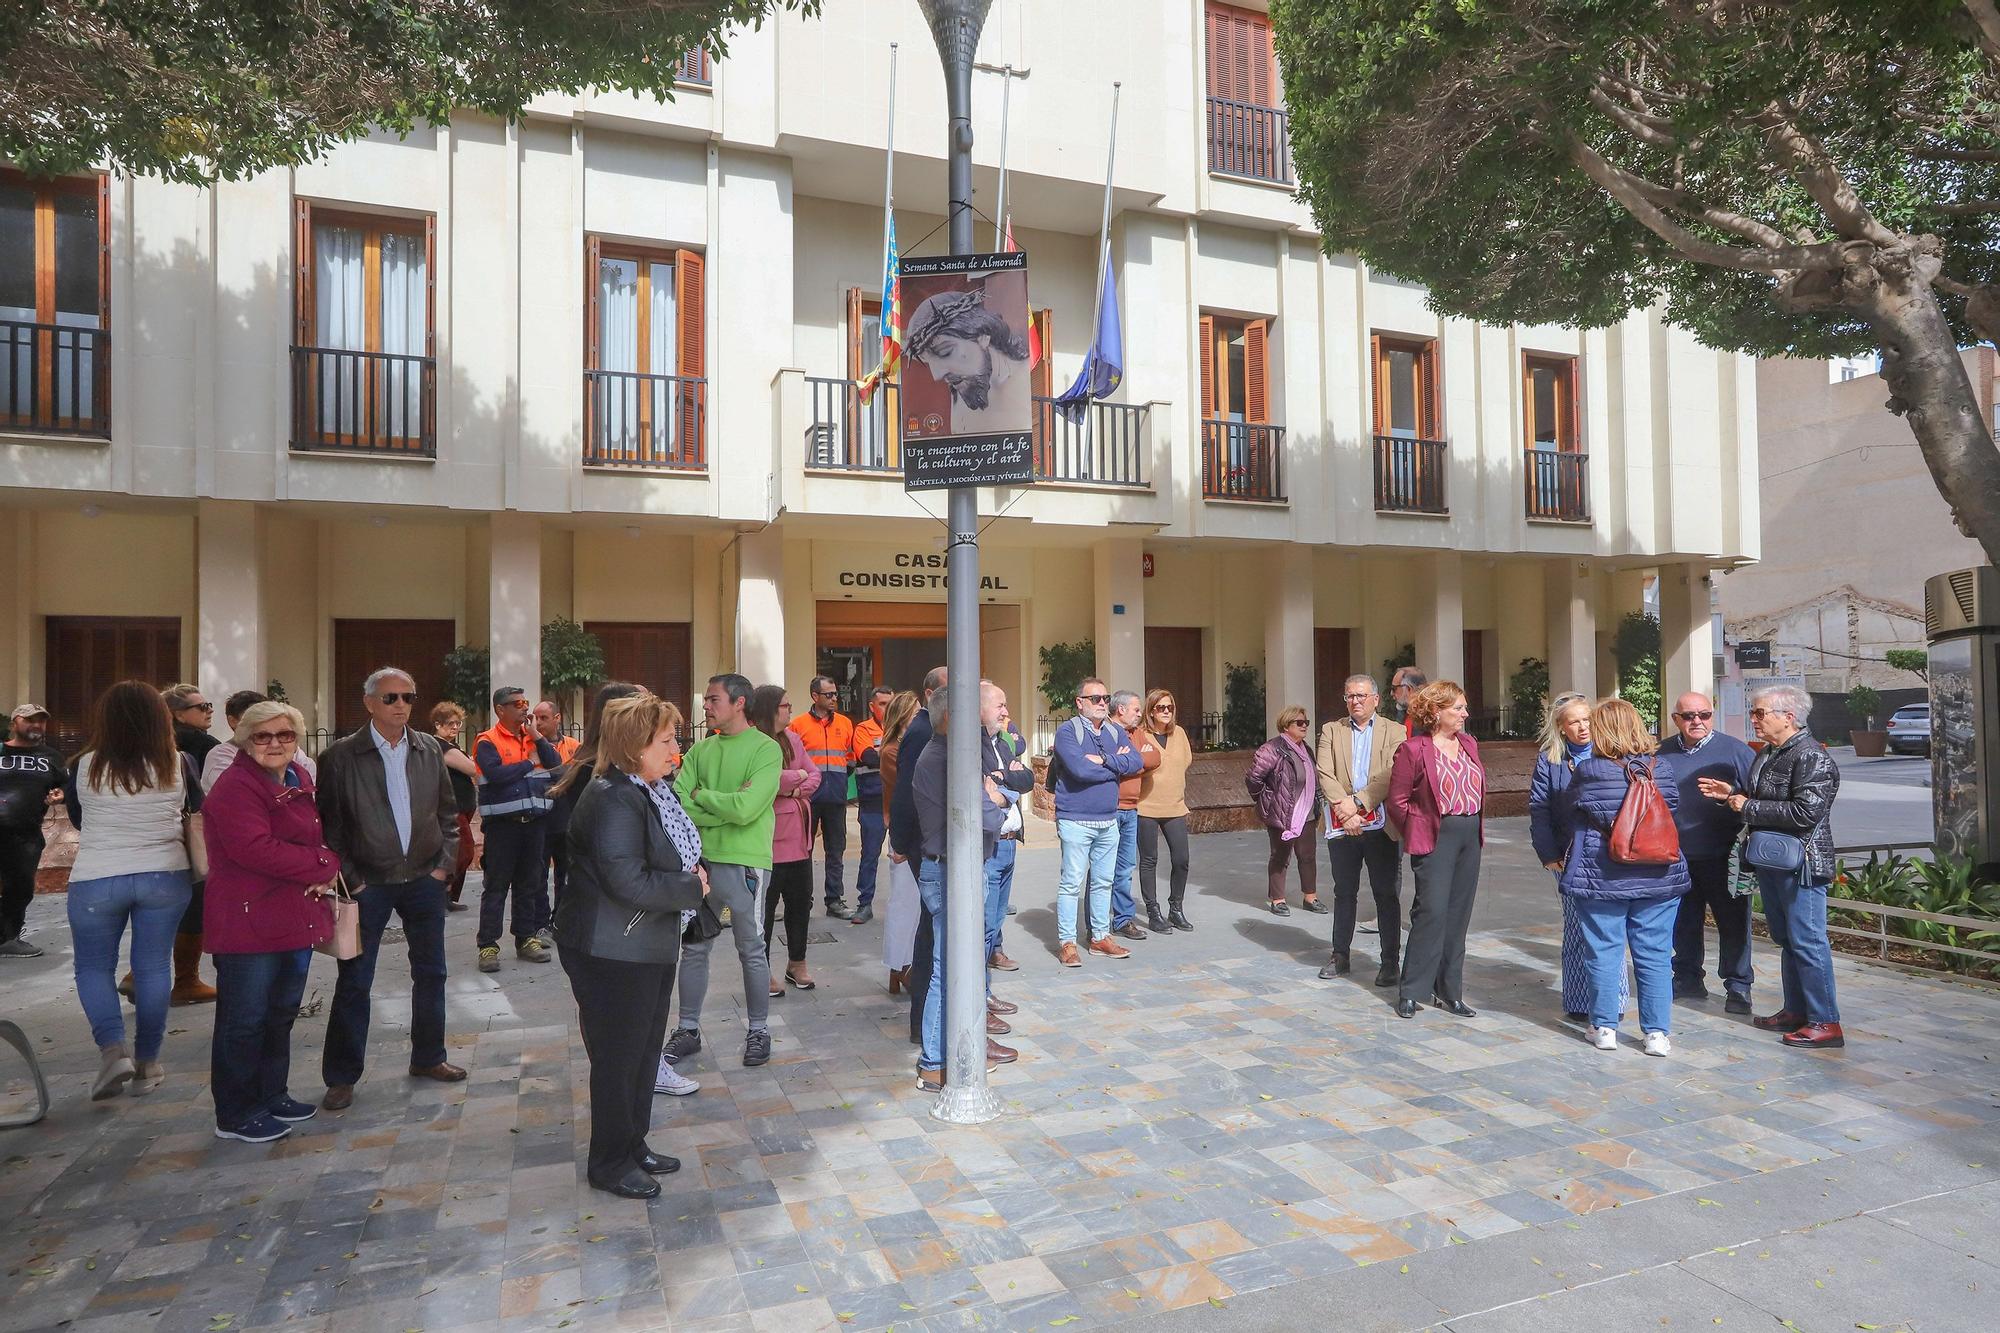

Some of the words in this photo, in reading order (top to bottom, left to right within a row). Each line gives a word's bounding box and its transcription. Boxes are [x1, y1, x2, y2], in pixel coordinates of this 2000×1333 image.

[904, 263, 938, 272] Semana
[940, 261, 965, 271] Santa
[968, 256, 978, 269] de
[981, 253, 1024, 268] Almoradí
[907, 448, 924, 457] Un
[928, 444, 978, 455] encuentro
[981, 443, 998, 452] con
[1003, 438, 1013, 450] la
[1013, 437, 1030, 454] fe,
[918, 457, 929, 469] la
[932, 456, 971, 469] cultura
[970, 458, 983, 471] y
[987, 452, 998, 464] el
[1001, 453, 1022, 463] arte
[909, 478, 947, 487] SIÉNTELA,
[949, 474, 995, 484] EMOCIÓNATE
[839, 573, 1009, 589] CONSISTAL
